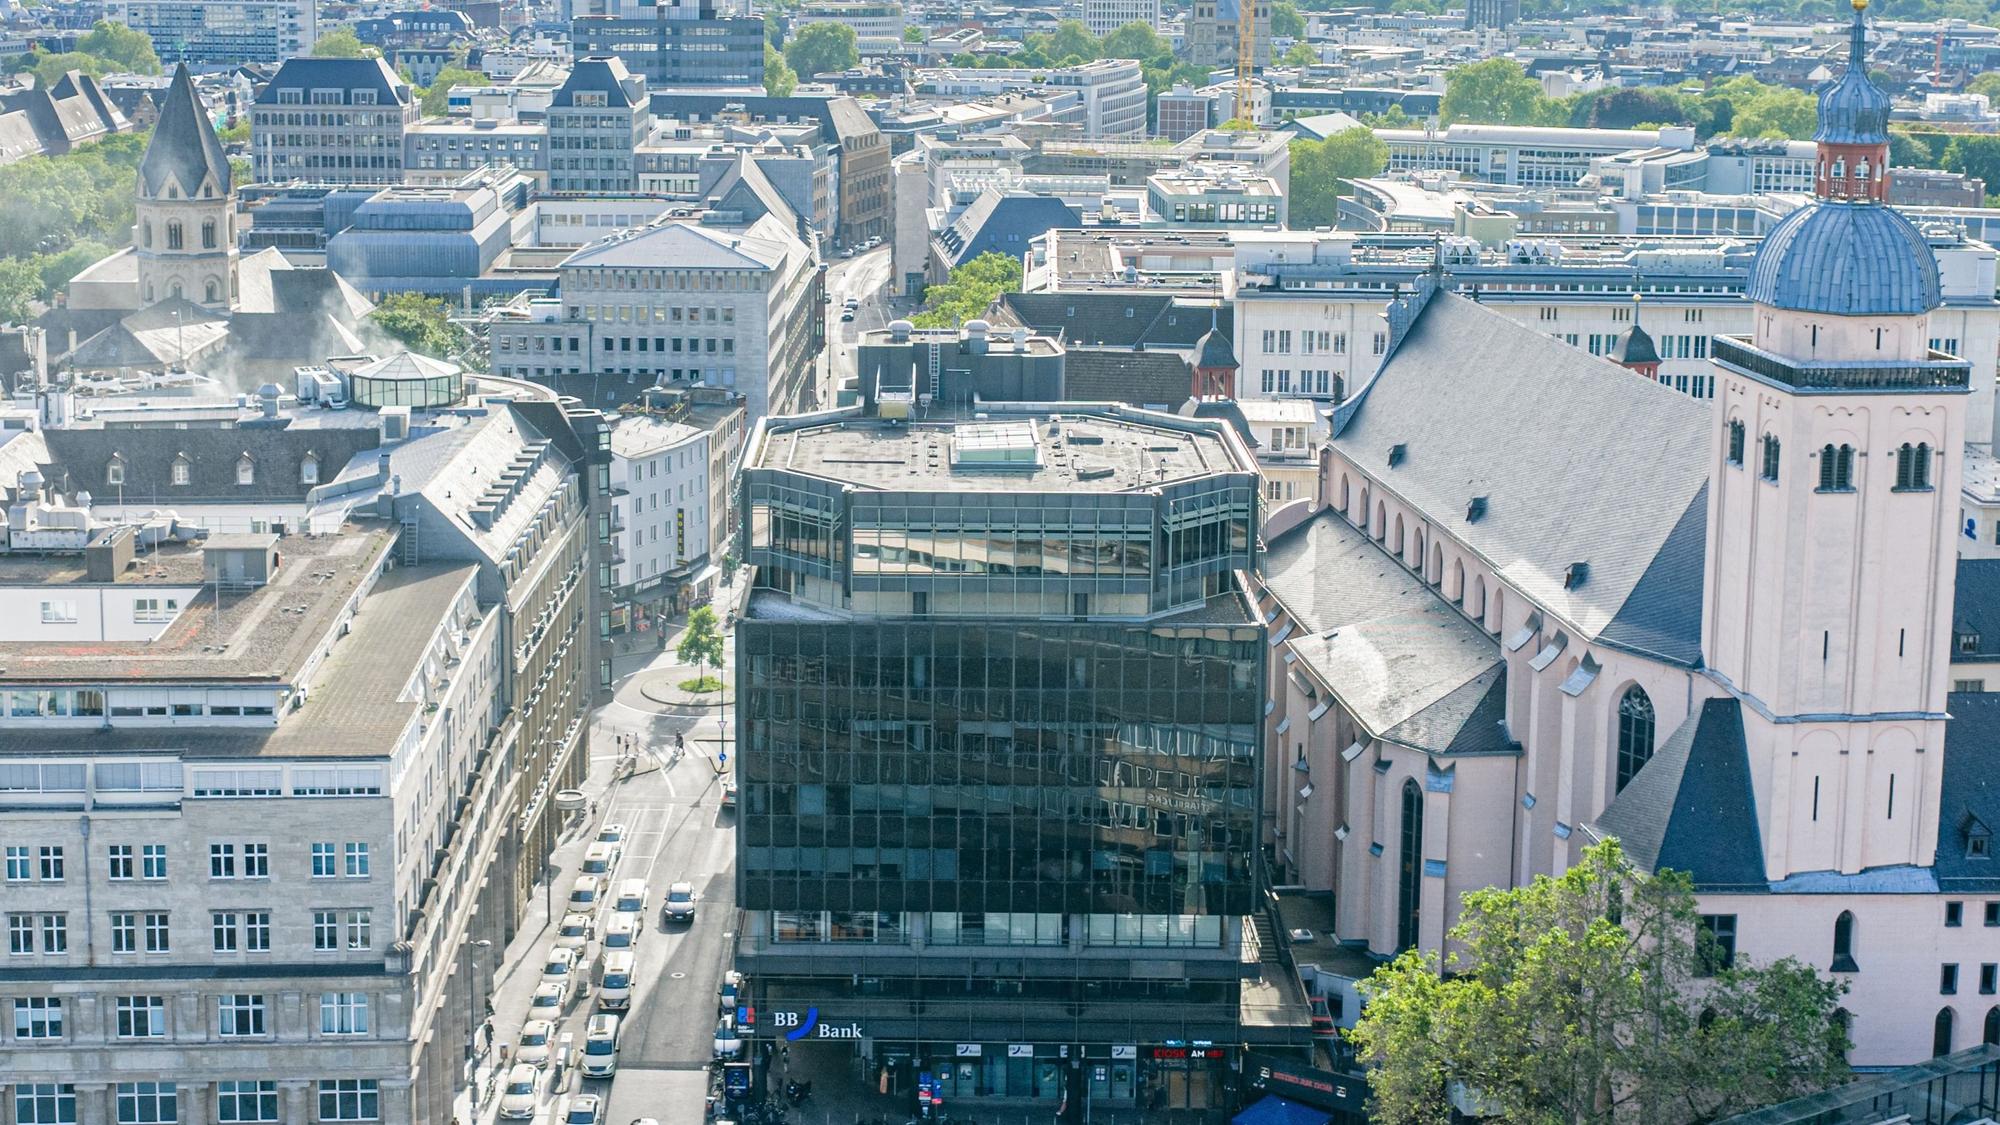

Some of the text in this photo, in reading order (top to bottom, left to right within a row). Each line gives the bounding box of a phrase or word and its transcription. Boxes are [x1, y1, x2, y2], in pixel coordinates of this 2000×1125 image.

[774, 1012, 863, 1038] BB Bank
[1153, 1047, 1186, 1058] KIOSK
[1190, 1049, 1205, 1058] AM
